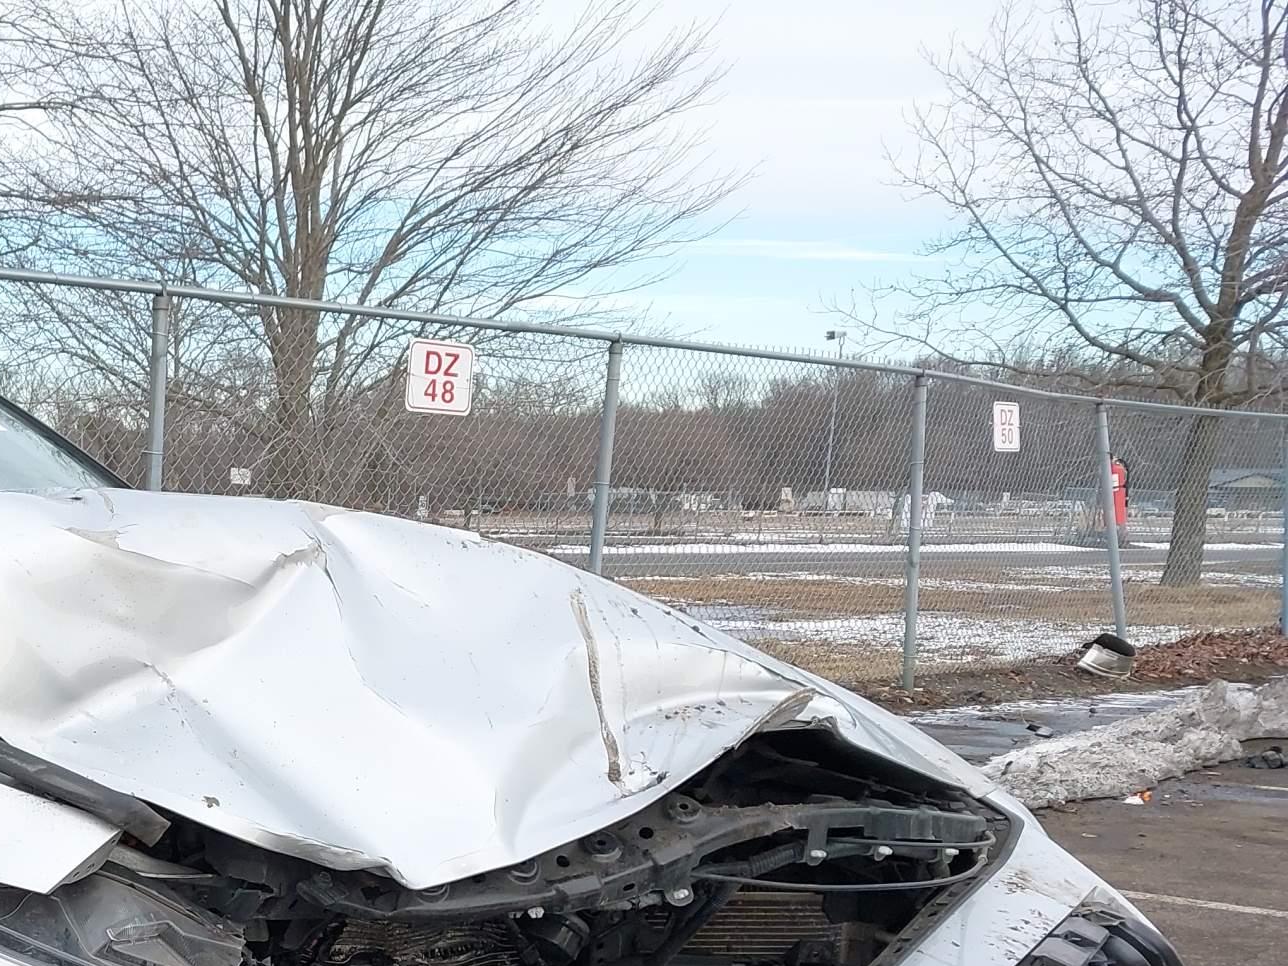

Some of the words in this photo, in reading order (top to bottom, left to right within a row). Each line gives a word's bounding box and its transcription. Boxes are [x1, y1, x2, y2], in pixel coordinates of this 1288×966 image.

[424, 351, 460, 377] DZ
[423, 379, 456, 404] 48
[1000, 409, 1014, 426] DZ
[1001, 428, 1014, 444] 50
